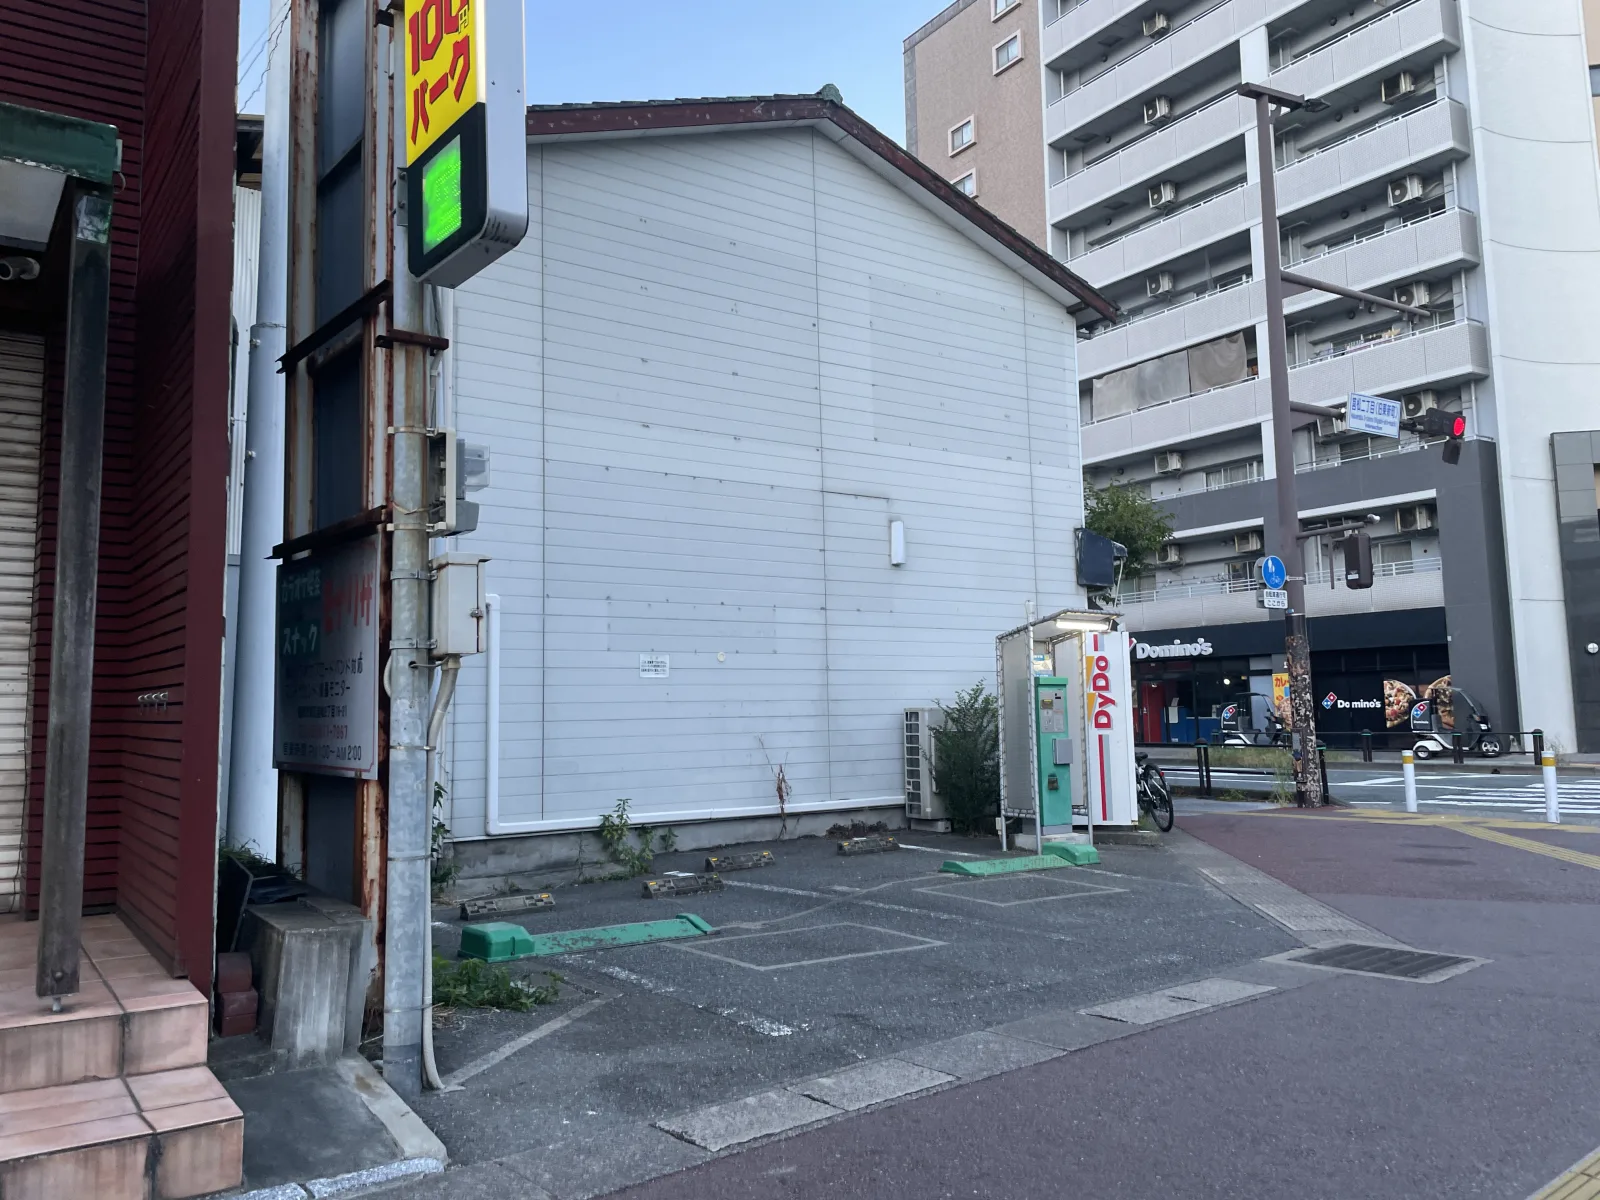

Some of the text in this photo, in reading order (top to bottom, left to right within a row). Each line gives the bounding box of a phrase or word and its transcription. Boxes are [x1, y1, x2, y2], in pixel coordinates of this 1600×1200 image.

[411, 35, 471, 145] パーク
[283, 624, 318, 655] スナック
[1136, 637, 1213, 659] Domino's
[1092, 655, 1116, 729] DyDo
